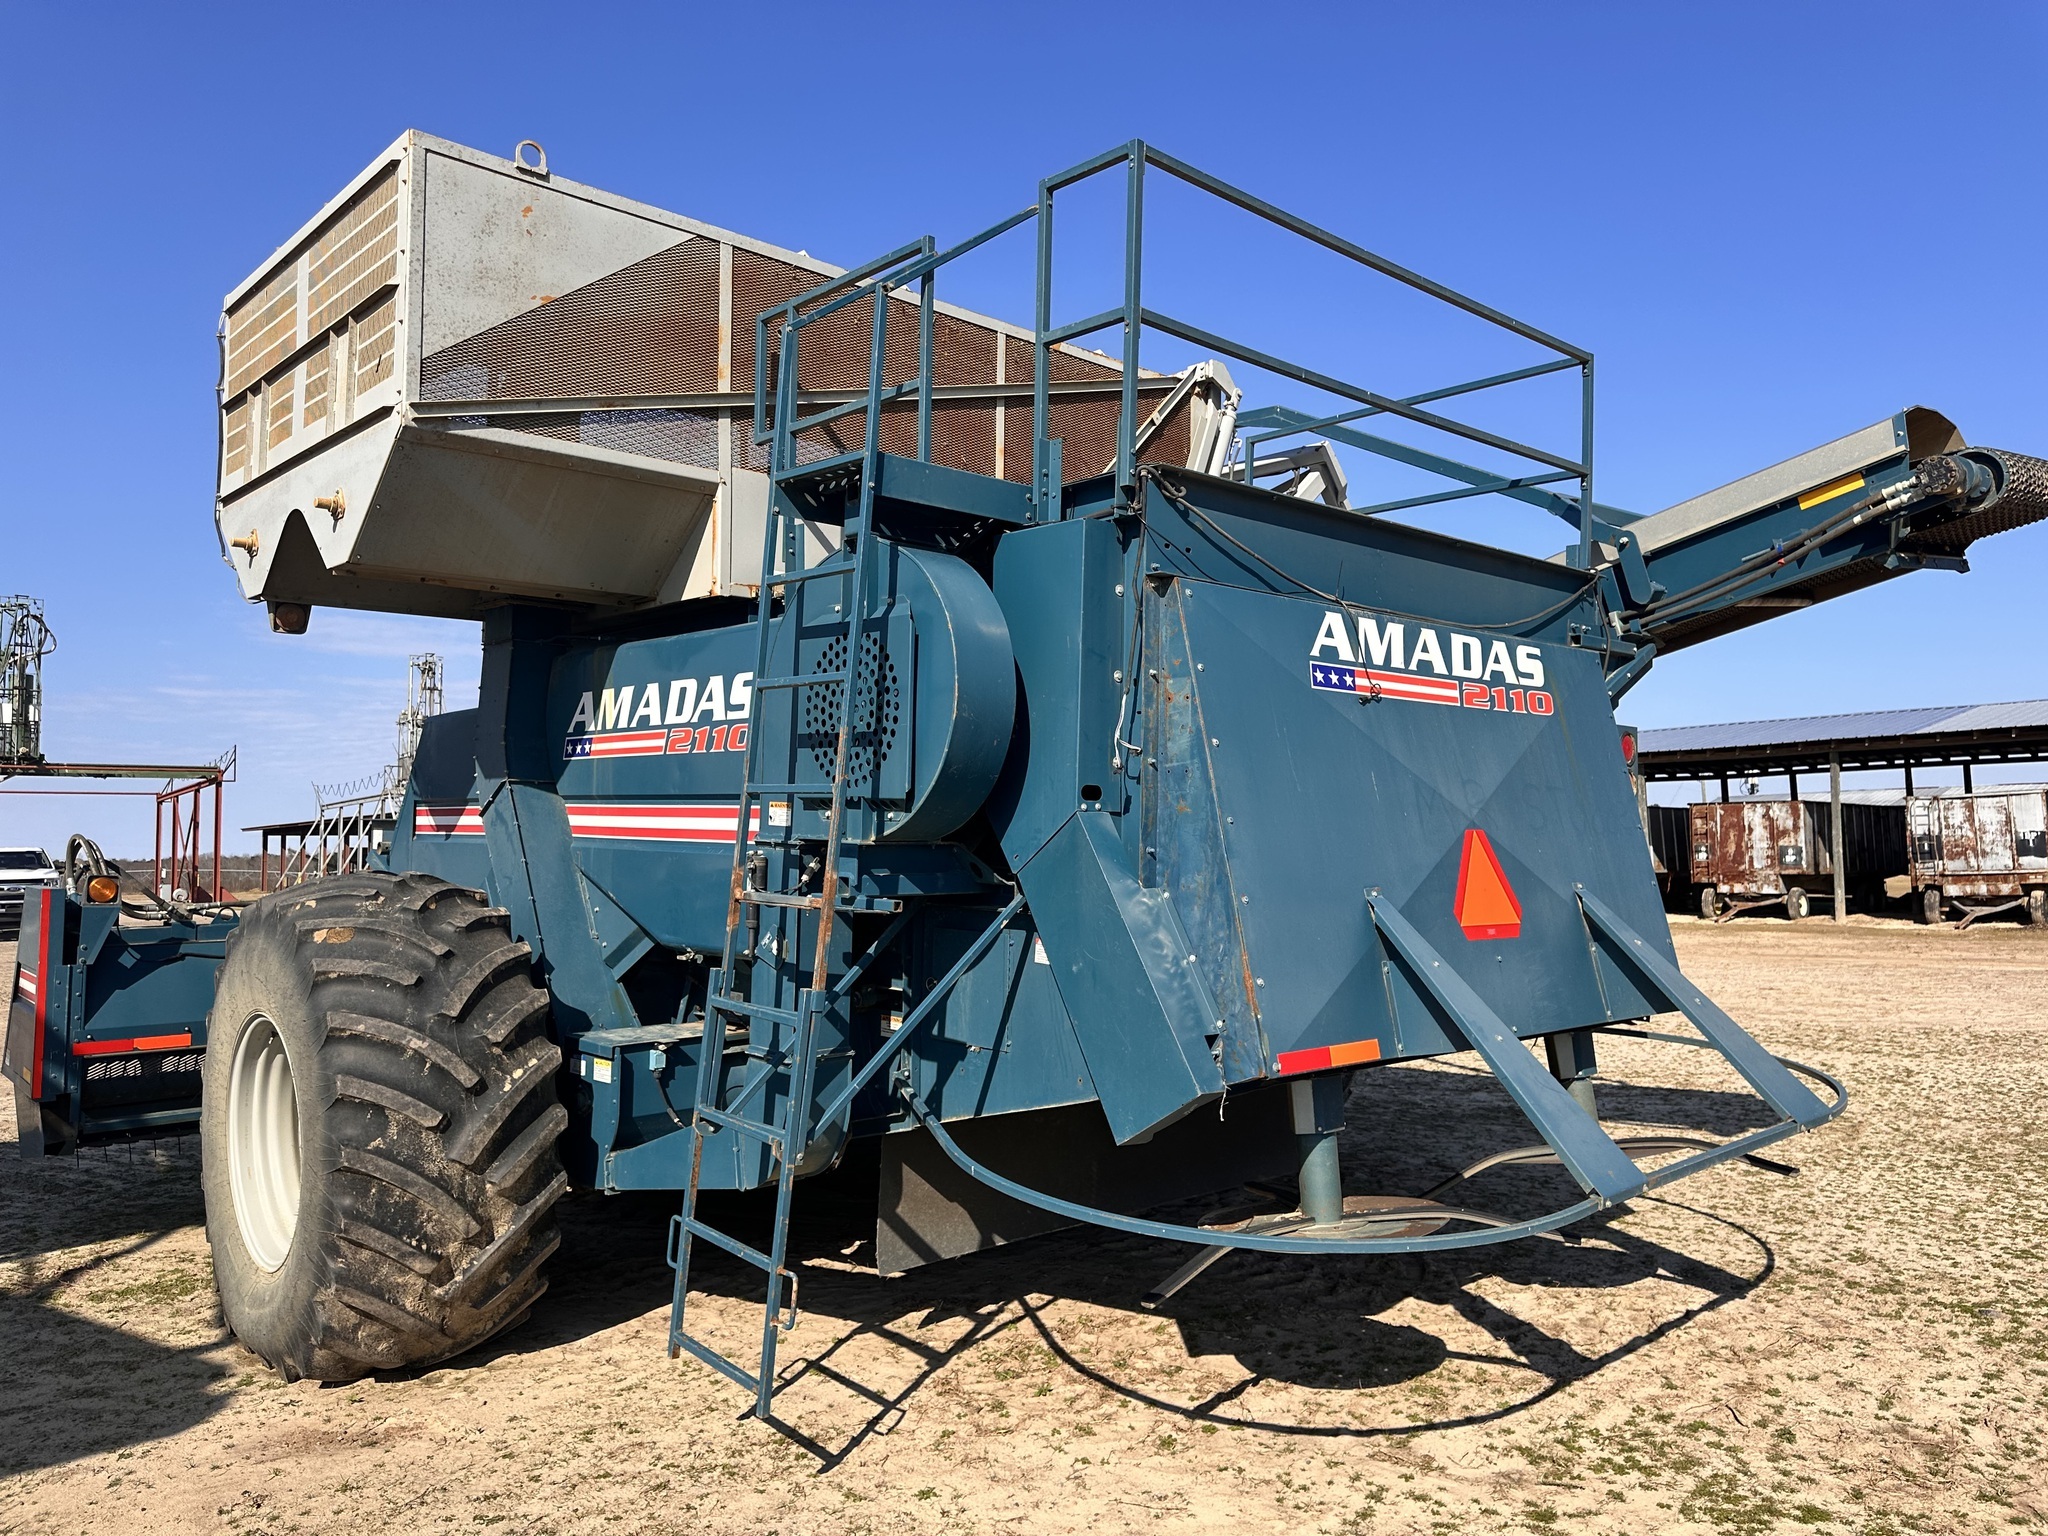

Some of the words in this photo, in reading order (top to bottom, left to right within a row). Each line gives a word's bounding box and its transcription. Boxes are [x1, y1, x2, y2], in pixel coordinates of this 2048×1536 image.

[1310, 610, 1545, 687] AMADAS
[567, 671, 754, 733] AMADAS
[1462, 681, 1554, 716] 2110
[666, 723, 749, 755] 2110
